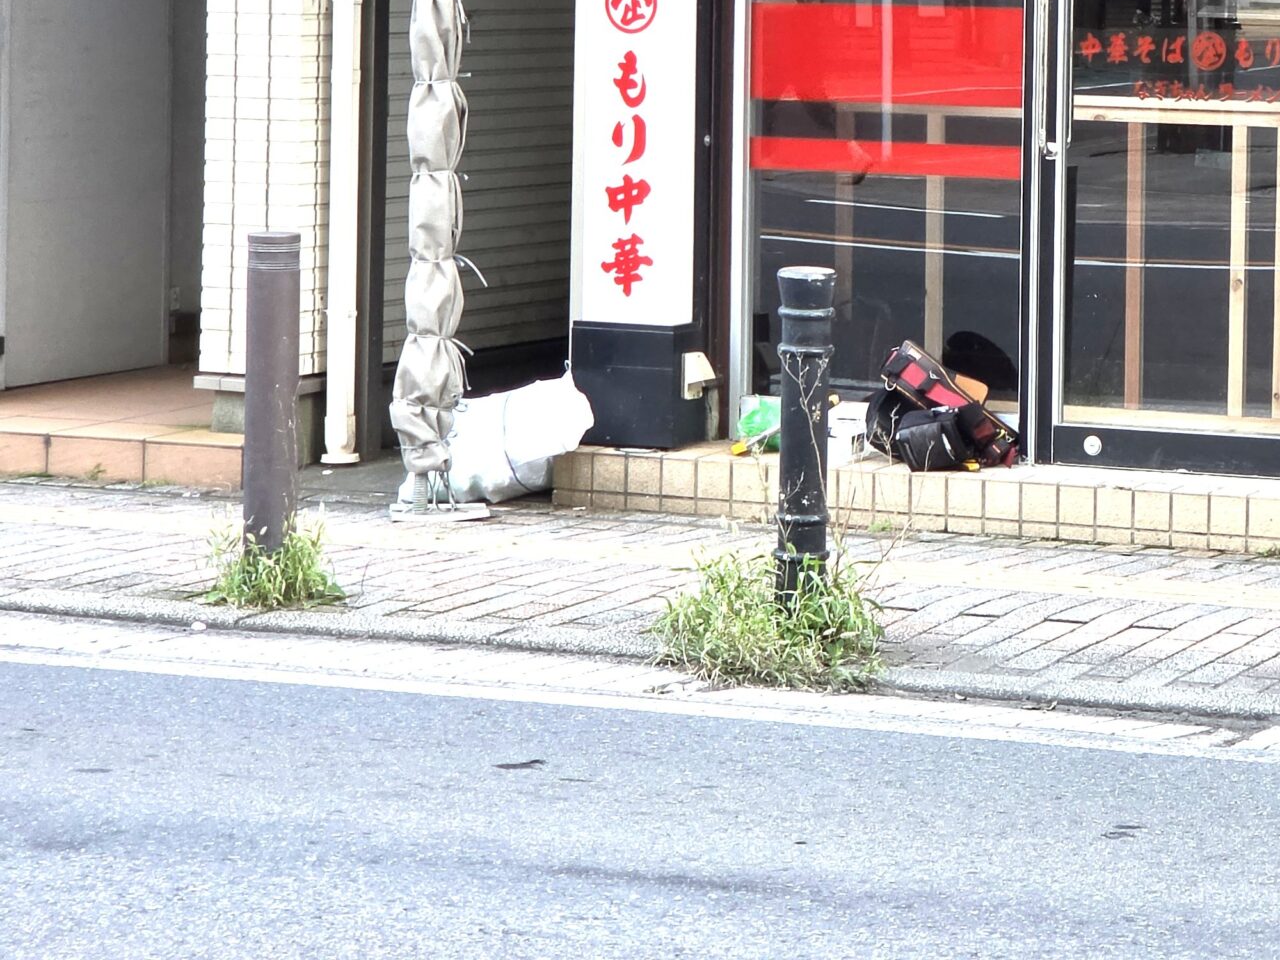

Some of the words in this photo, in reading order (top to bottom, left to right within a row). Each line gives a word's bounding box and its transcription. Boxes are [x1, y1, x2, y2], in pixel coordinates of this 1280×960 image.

[1079, 32, 1184, 64] 中華そば
[600, 50, 654, 297] もり中華
